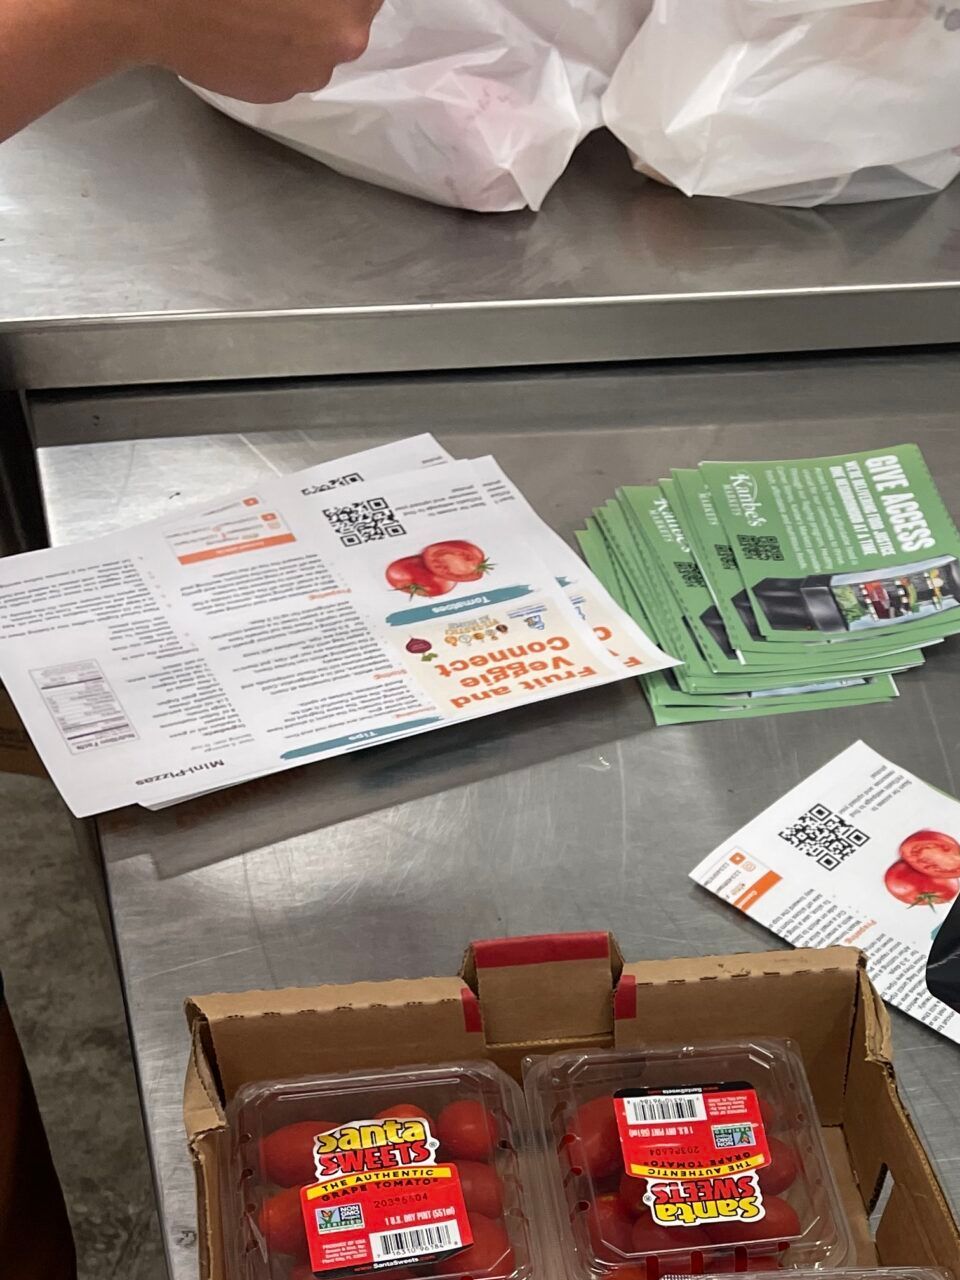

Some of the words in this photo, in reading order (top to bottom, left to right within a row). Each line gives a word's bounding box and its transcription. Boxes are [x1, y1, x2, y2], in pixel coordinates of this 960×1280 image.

[866, 454, 910, 490] GIVE
[728, 472, 767, 527] Kanbe's
[852, 523, 867, 533] AT
[880, 492, 935, 552] ACCESS
[858, 539, 878, 555] TIME
[872, 530, 896, 556] JUSTICE
[429, 593, 490, 616] Tomatoes
[432, 631, 573, 681] Connect
[455, 648, 574, 693] Veggie
[517, 663, 598, 693] Fruit
[449, 684, 513, 709] and
[348, 729, 376, 741] Tips
[317, 1120, 425, 1154] Santa
[318, 1140, 430, 1176] SWEETS
[709, 1151, 750, 1165] GRAPE
[728, 1160, 750, 1171] THE
[322, 1179, 347, 1192] THE
[355, 1169, 433, 1183] AUTHENTIC
[647, 1167, 720, 1176] AUTHENTIC
[321, 1184, 367, 1201] GRAPE
[650, 1176, 755, 1203] SWEETS
[340, 1204, 358, 1212] NON
[654, 1197, 760, 1224] Santa
